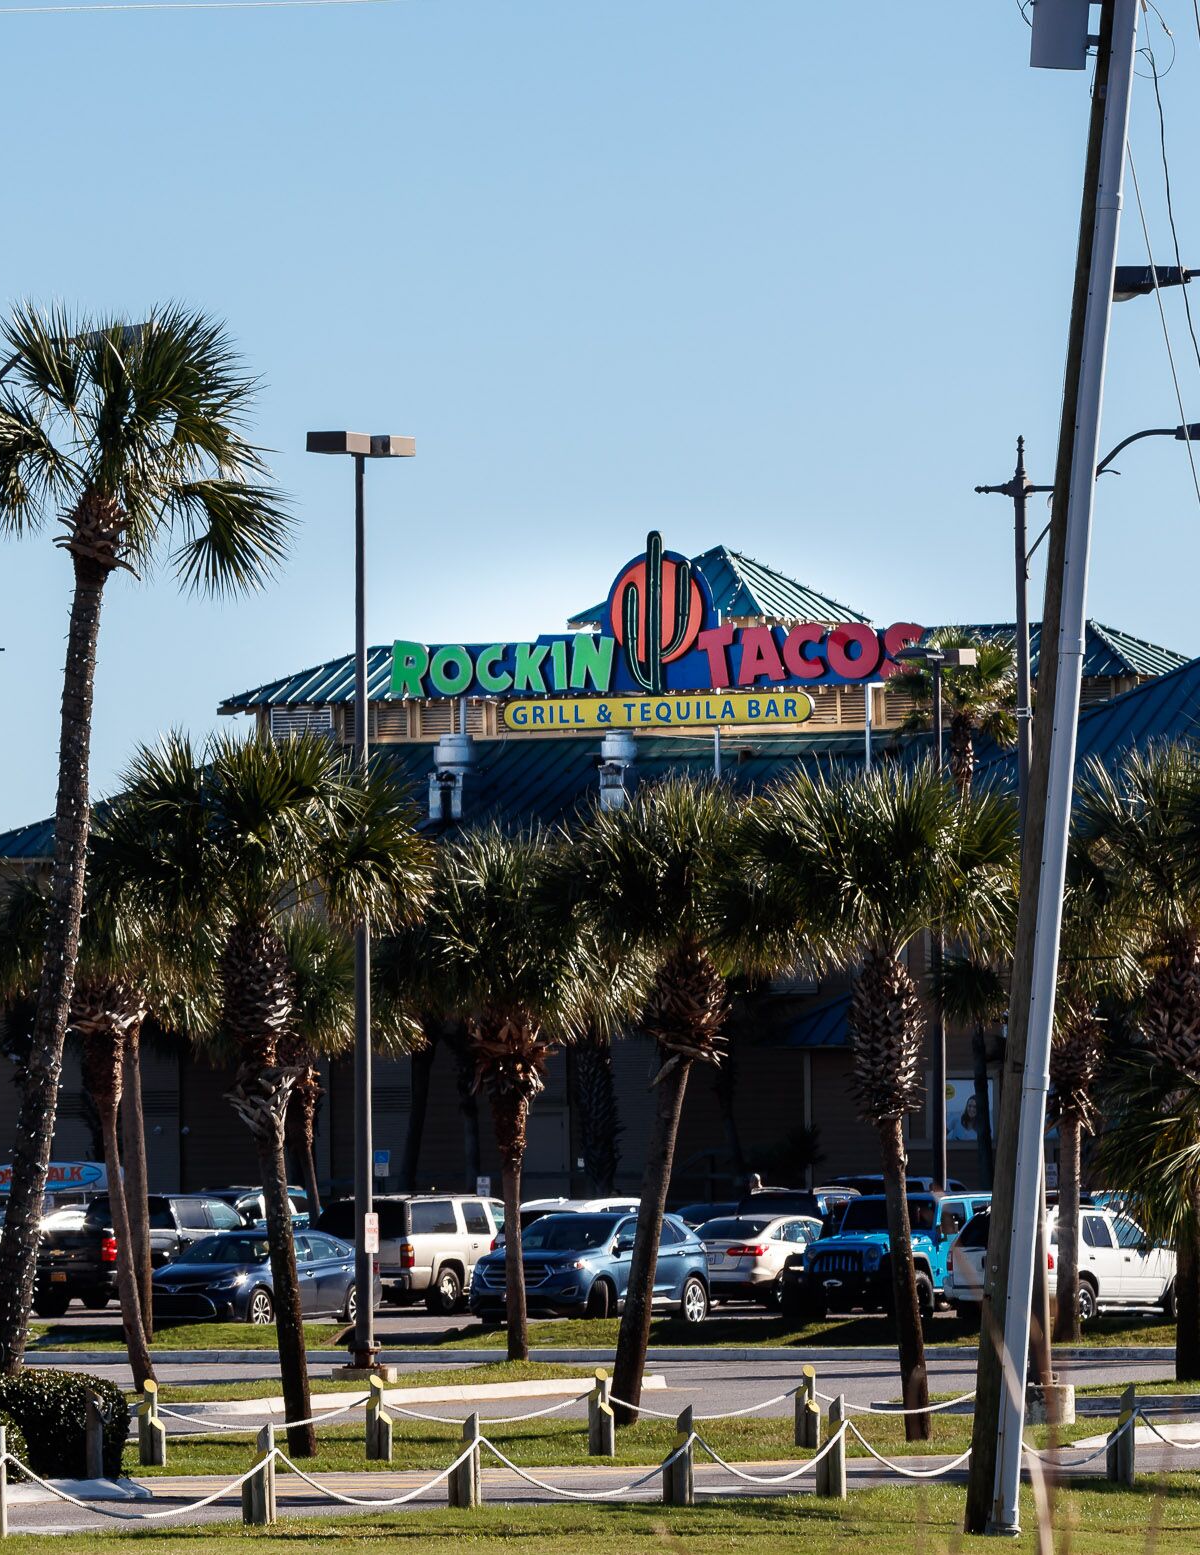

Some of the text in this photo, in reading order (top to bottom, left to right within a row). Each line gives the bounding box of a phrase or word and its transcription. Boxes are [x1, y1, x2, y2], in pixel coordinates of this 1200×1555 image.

[390, 633, 615, 698] ROCKIN
[512, 698, 798, 725] GRILL & TEQUILA BAR
